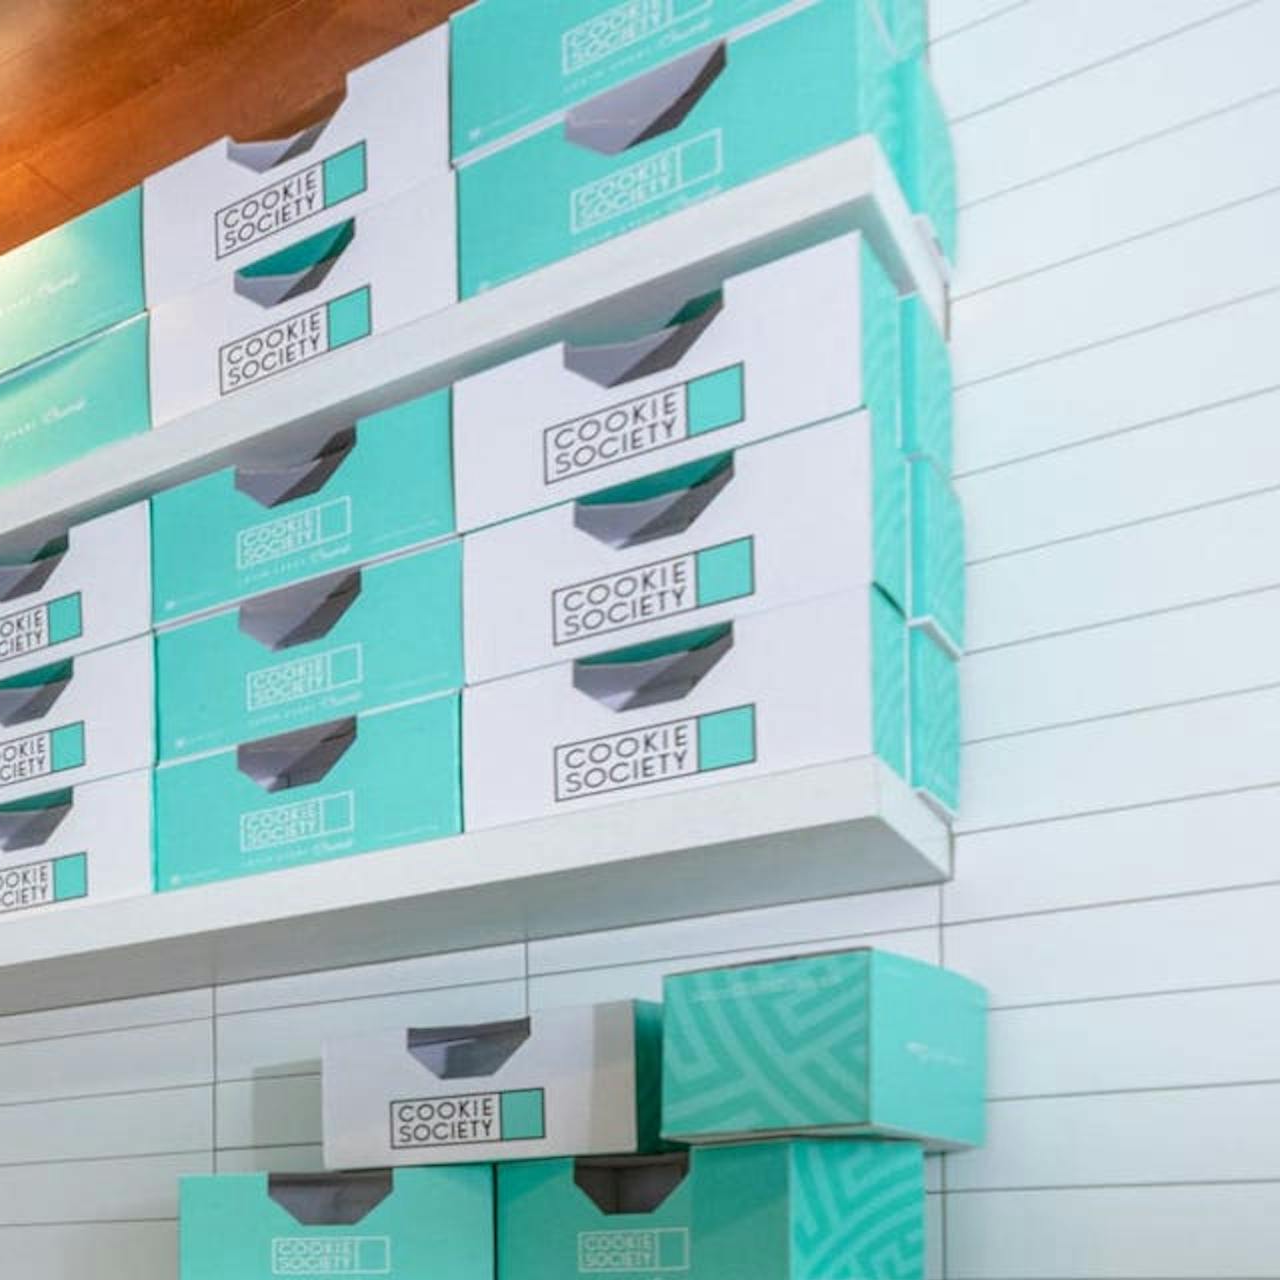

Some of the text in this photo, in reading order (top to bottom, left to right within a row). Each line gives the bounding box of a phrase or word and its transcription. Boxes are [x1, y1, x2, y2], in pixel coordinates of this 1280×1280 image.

[223, 170, 317, 229] COOKIE
[224, 192, 317, 250] SOCIETY
[227, 311, 321, 365] COOKIE
[228, 332, 321, 386] SOCIETY
[554, 392, 677, 450] COOKIE
[555, 418, 678, 475] SOCIETY
[563, 560, 686, 613] COOKIE
[564, 586, 687, 638] SOCIETY
[564, 725, 688, 769] COOKIE
[565, 749, 688, 794] SOCIETY
[398, 1098, 493, 1123] COOKIE
[399, 1119, 492, 1143] SOCIETY
[584, 1233, 653, 1251] COOKIE
[584, 1251, 653, 1268] SOCIETY
